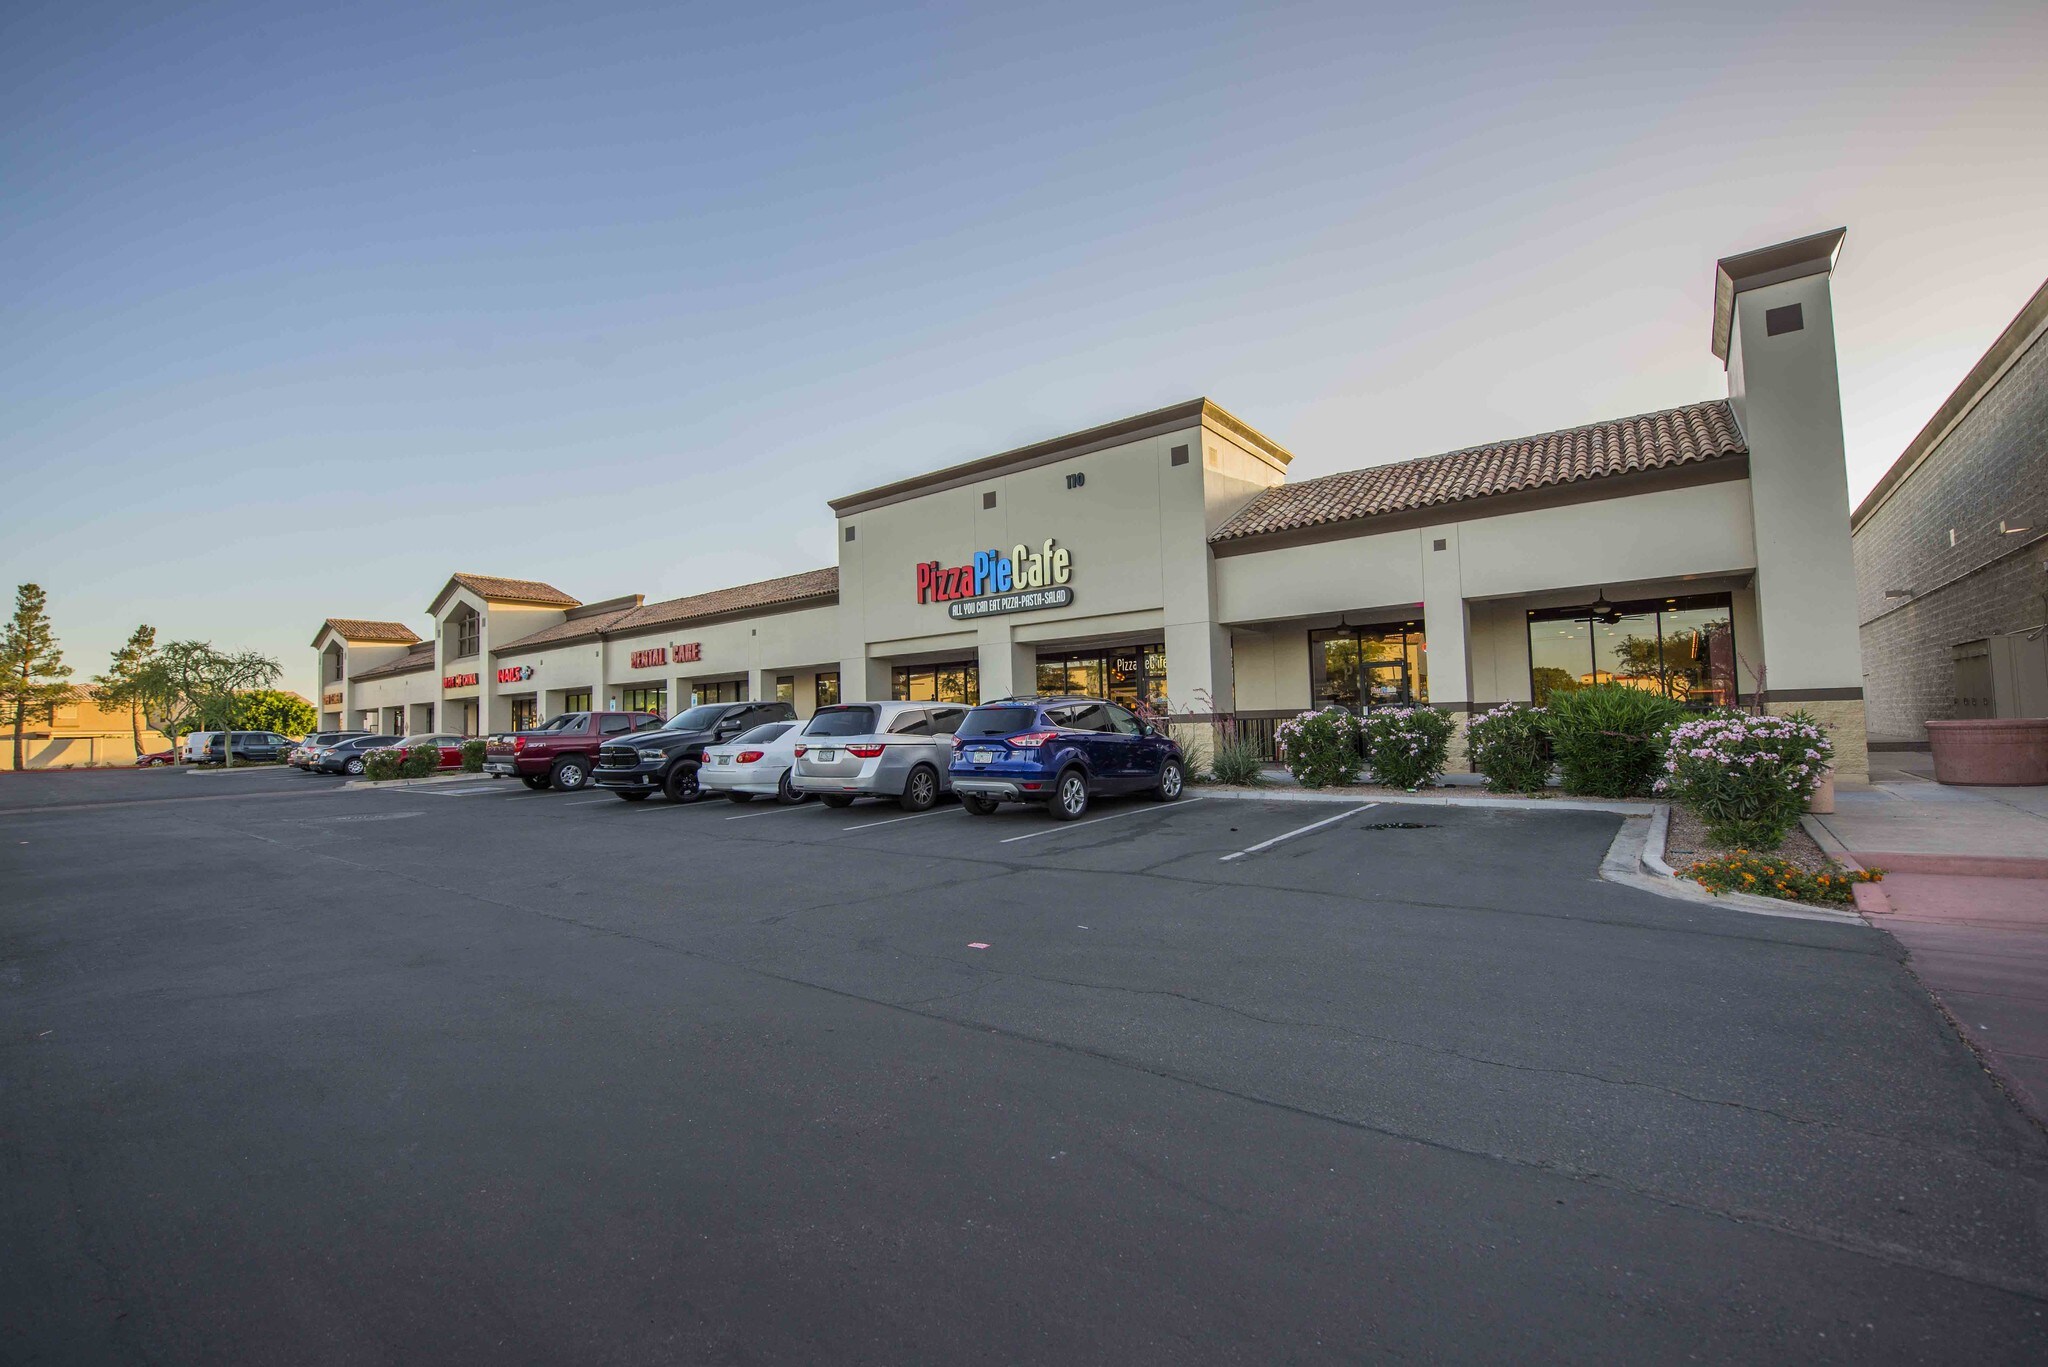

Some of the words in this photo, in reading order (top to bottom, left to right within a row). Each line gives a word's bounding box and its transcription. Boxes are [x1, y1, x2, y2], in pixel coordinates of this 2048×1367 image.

[1066, 472, 1085, 489] 110
[952, 604, 962, 616] ALL
[964, 602, 975, 614] YOU
[976, 601, 988, 613] CAN
[989, 598, 1001, 611] EAT
[631, 648, 667, 669] DENTAL
[672, 642, 702, 663] CARE
[497, 666, 522, 684] NAILS
